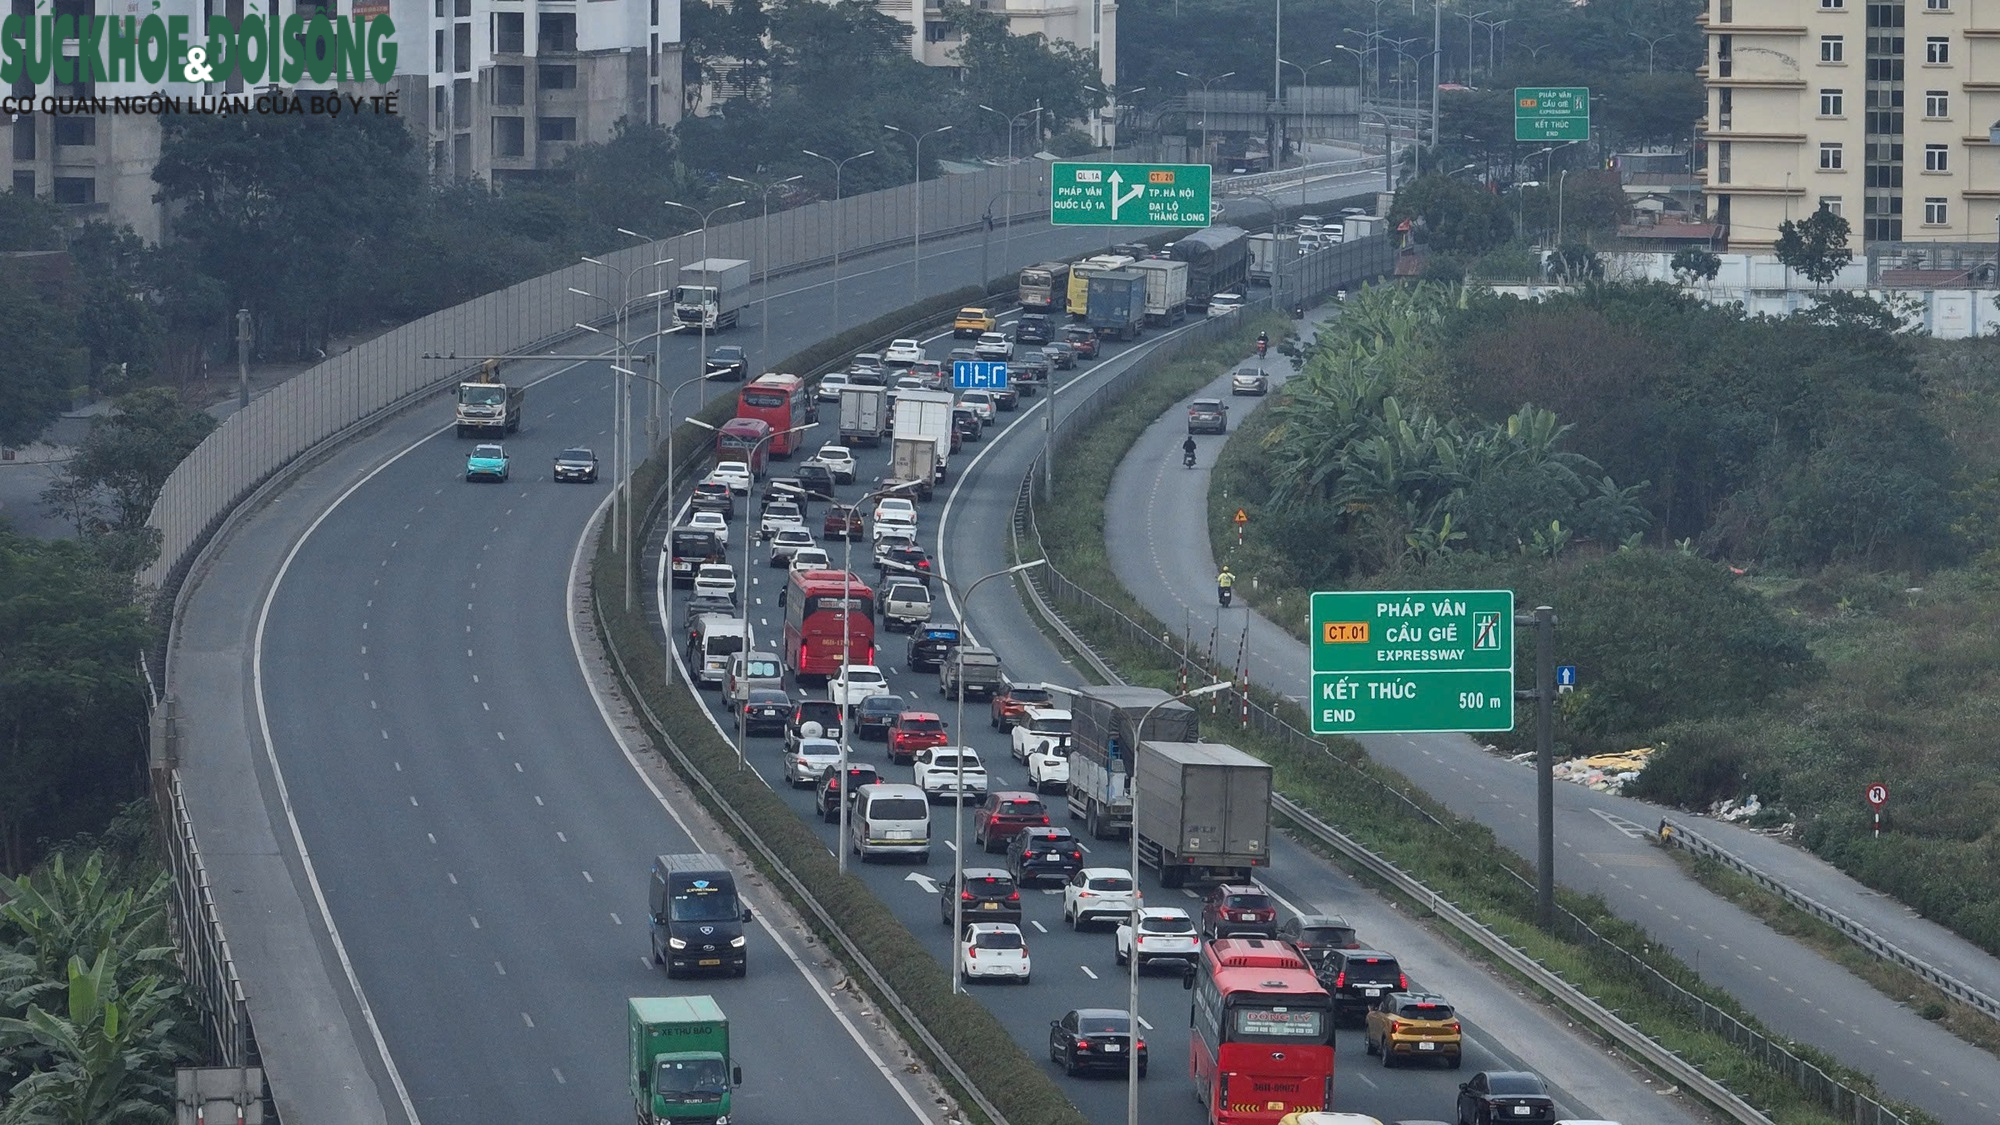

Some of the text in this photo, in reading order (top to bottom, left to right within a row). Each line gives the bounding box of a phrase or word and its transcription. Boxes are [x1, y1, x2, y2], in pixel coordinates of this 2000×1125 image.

[1058, 185, 1102, 196] PHÁP VÂN
[1179, 187, 1195, 200] NỘI
[1054, 198, 1106, 212] QUỐC LỘ 1A
[1149, 200, 1179, 213] ĐẠI LỘ
[1181, 213, 1205, 222] LONG
[1377, 598, 1466, 617] PHÁP VÂN
[1328, 626, 1365, 640] CT.01
[1386, 622, 1458, 643] CẦU GIẼ
[1377, 649, 1465, 661] EXPRESSWAY
[1323, 676, 1417, 700] KẾT THÚC
[1459, 692, 1501, 709] 500 m
[1323, 709, 1355, 722] END
[661, 1028, 672, 1036] XE
